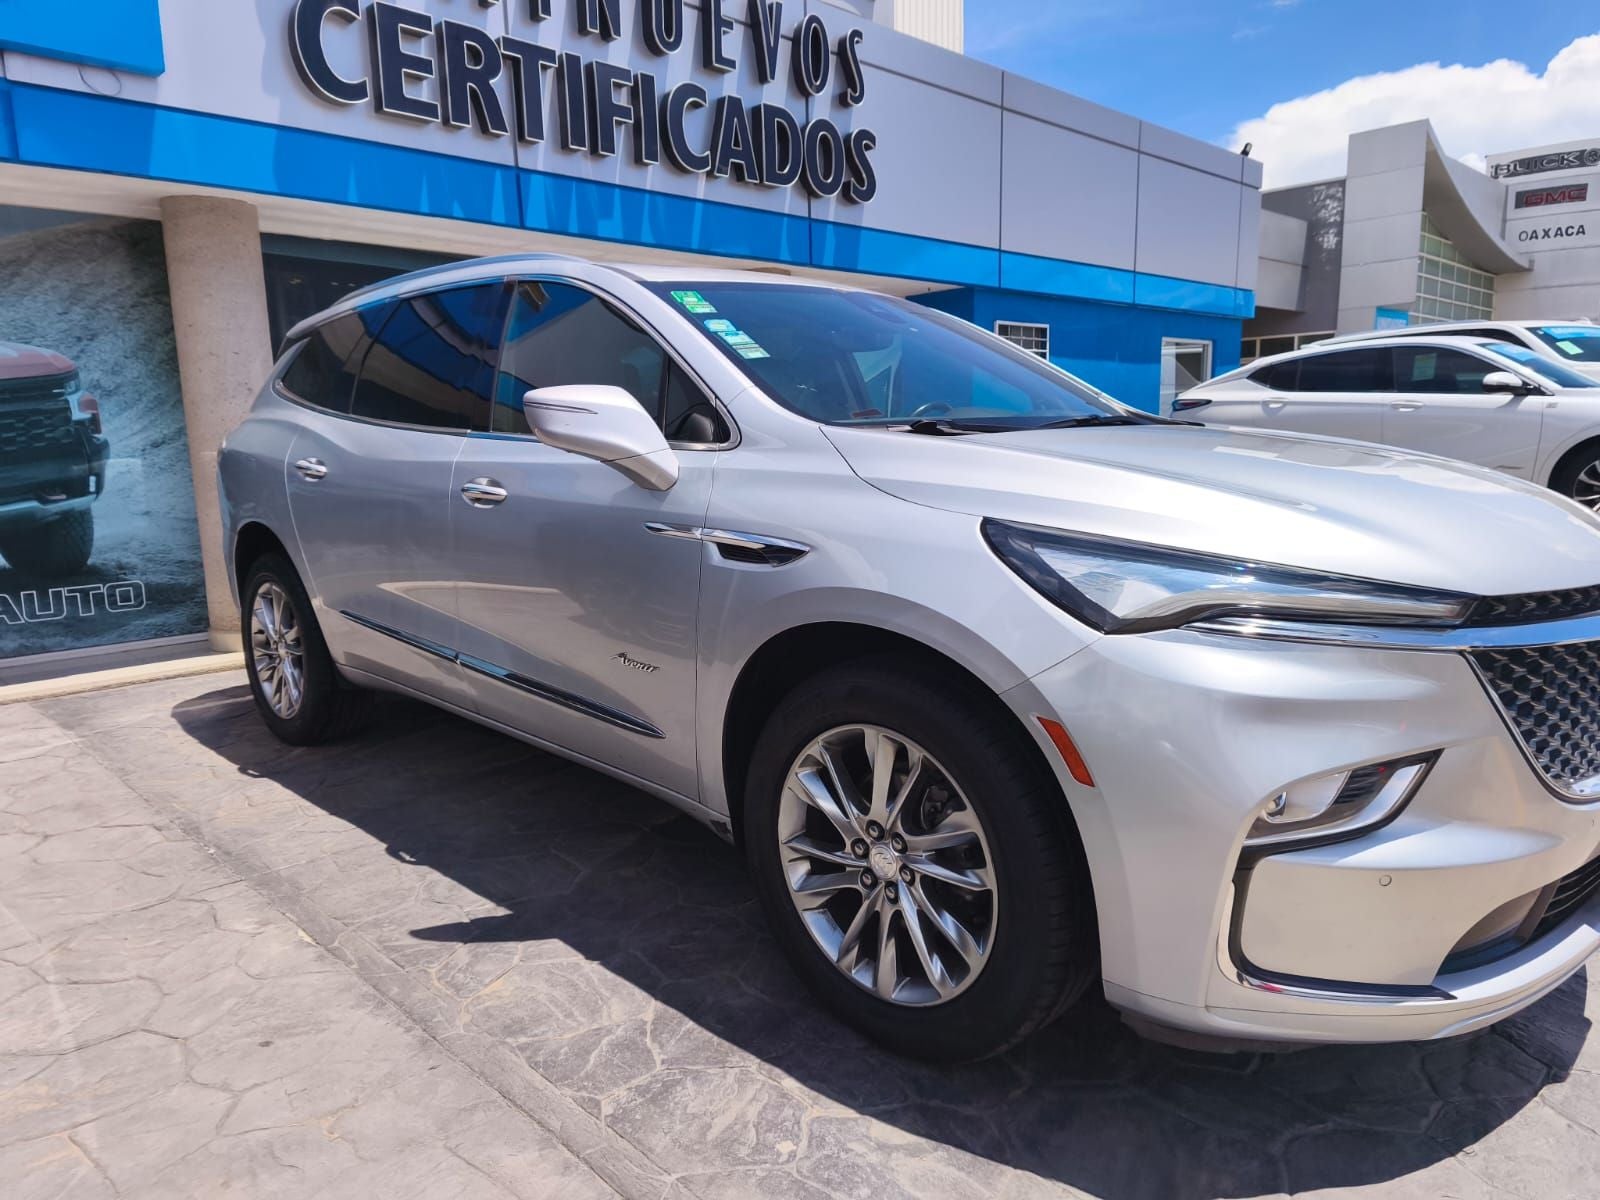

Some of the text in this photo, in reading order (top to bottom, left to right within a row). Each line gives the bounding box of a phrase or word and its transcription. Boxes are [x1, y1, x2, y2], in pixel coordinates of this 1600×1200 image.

[289, 0, 877, 204] CERTIFICADOS
[1491, 151, 1580, 179] BUICK
[1523, 188, 1586, 207] GMC
[1518, 224, 1586, 242] OAXACA
